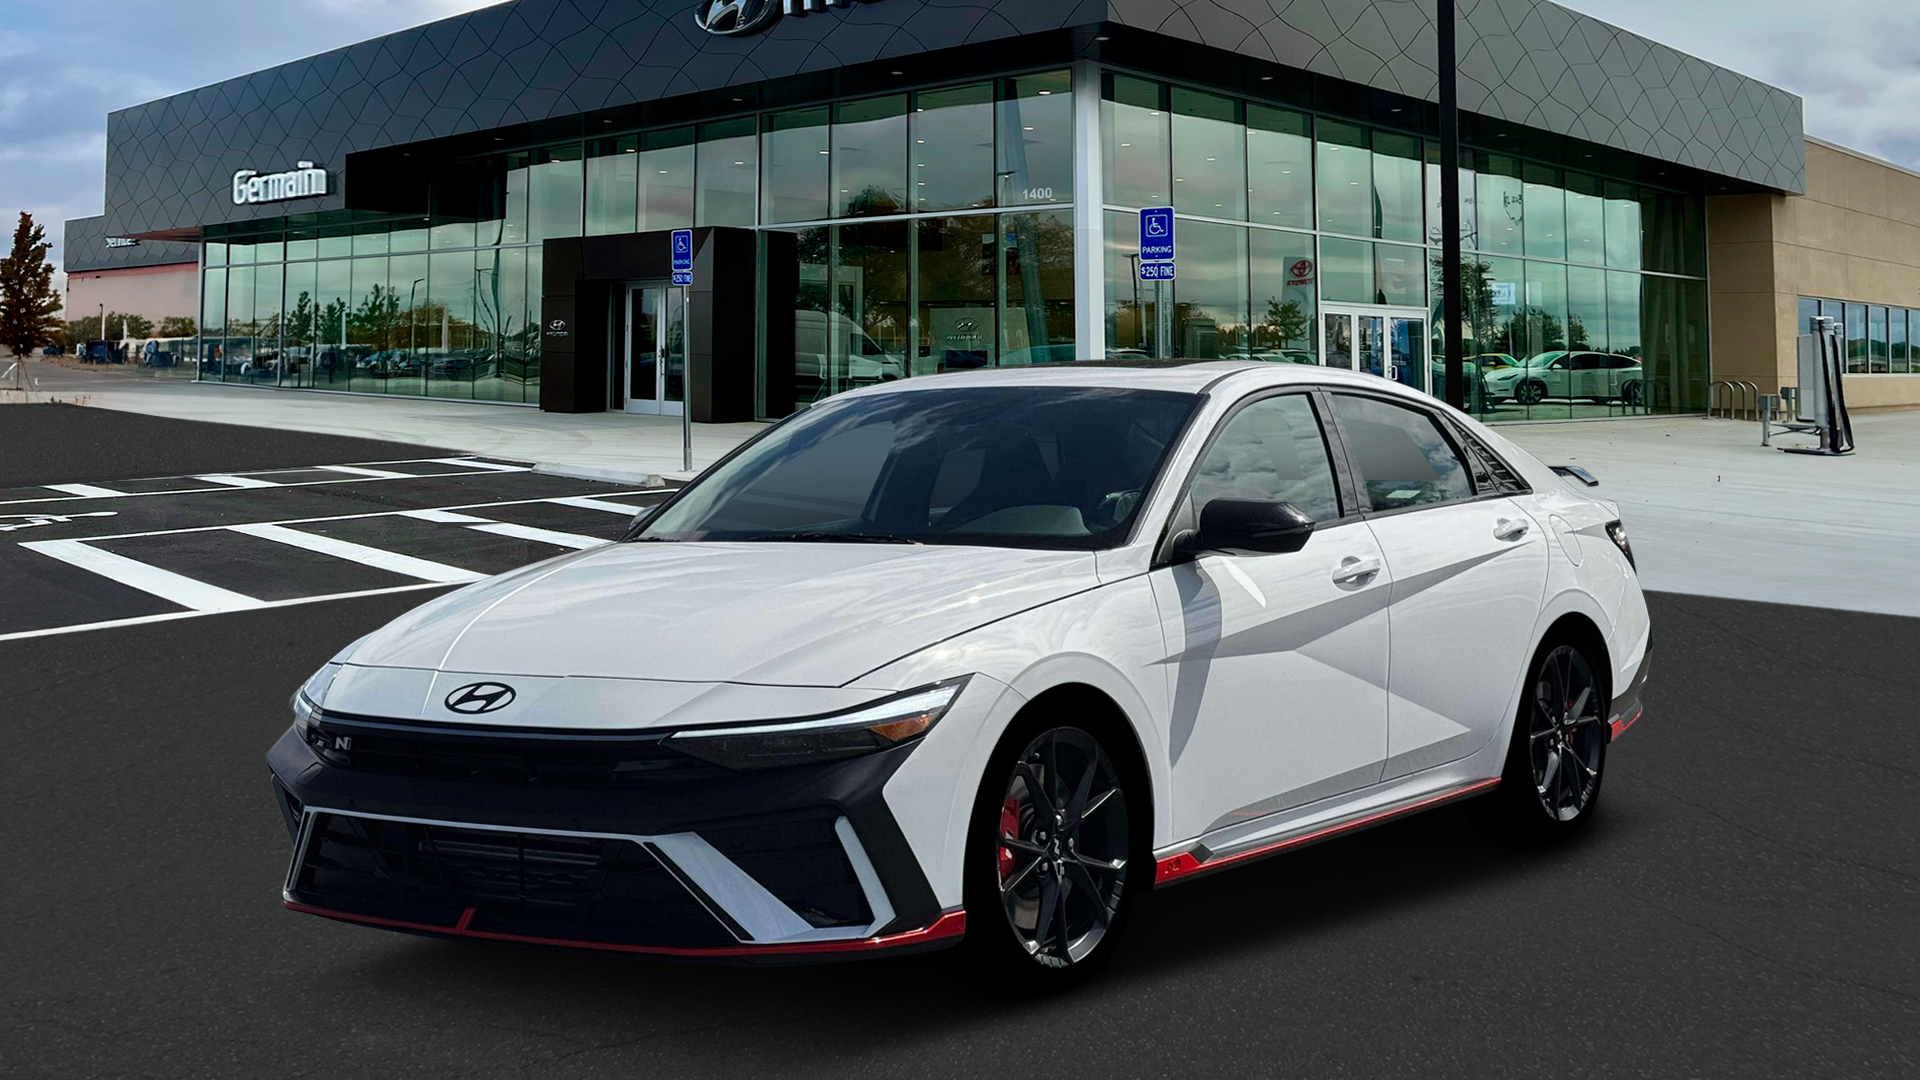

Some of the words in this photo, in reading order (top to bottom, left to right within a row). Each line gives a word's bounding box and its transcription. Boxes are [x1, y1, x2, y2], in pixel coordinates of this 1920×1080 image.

[233, 160, 327, 205] Germain
[1022, 187, 1053, 200] 1400
[1142, 245, 1173, 254] PARKING
[1141, 265, 1159, 278] $250
[1160, 265, 1174, 277] FINE
